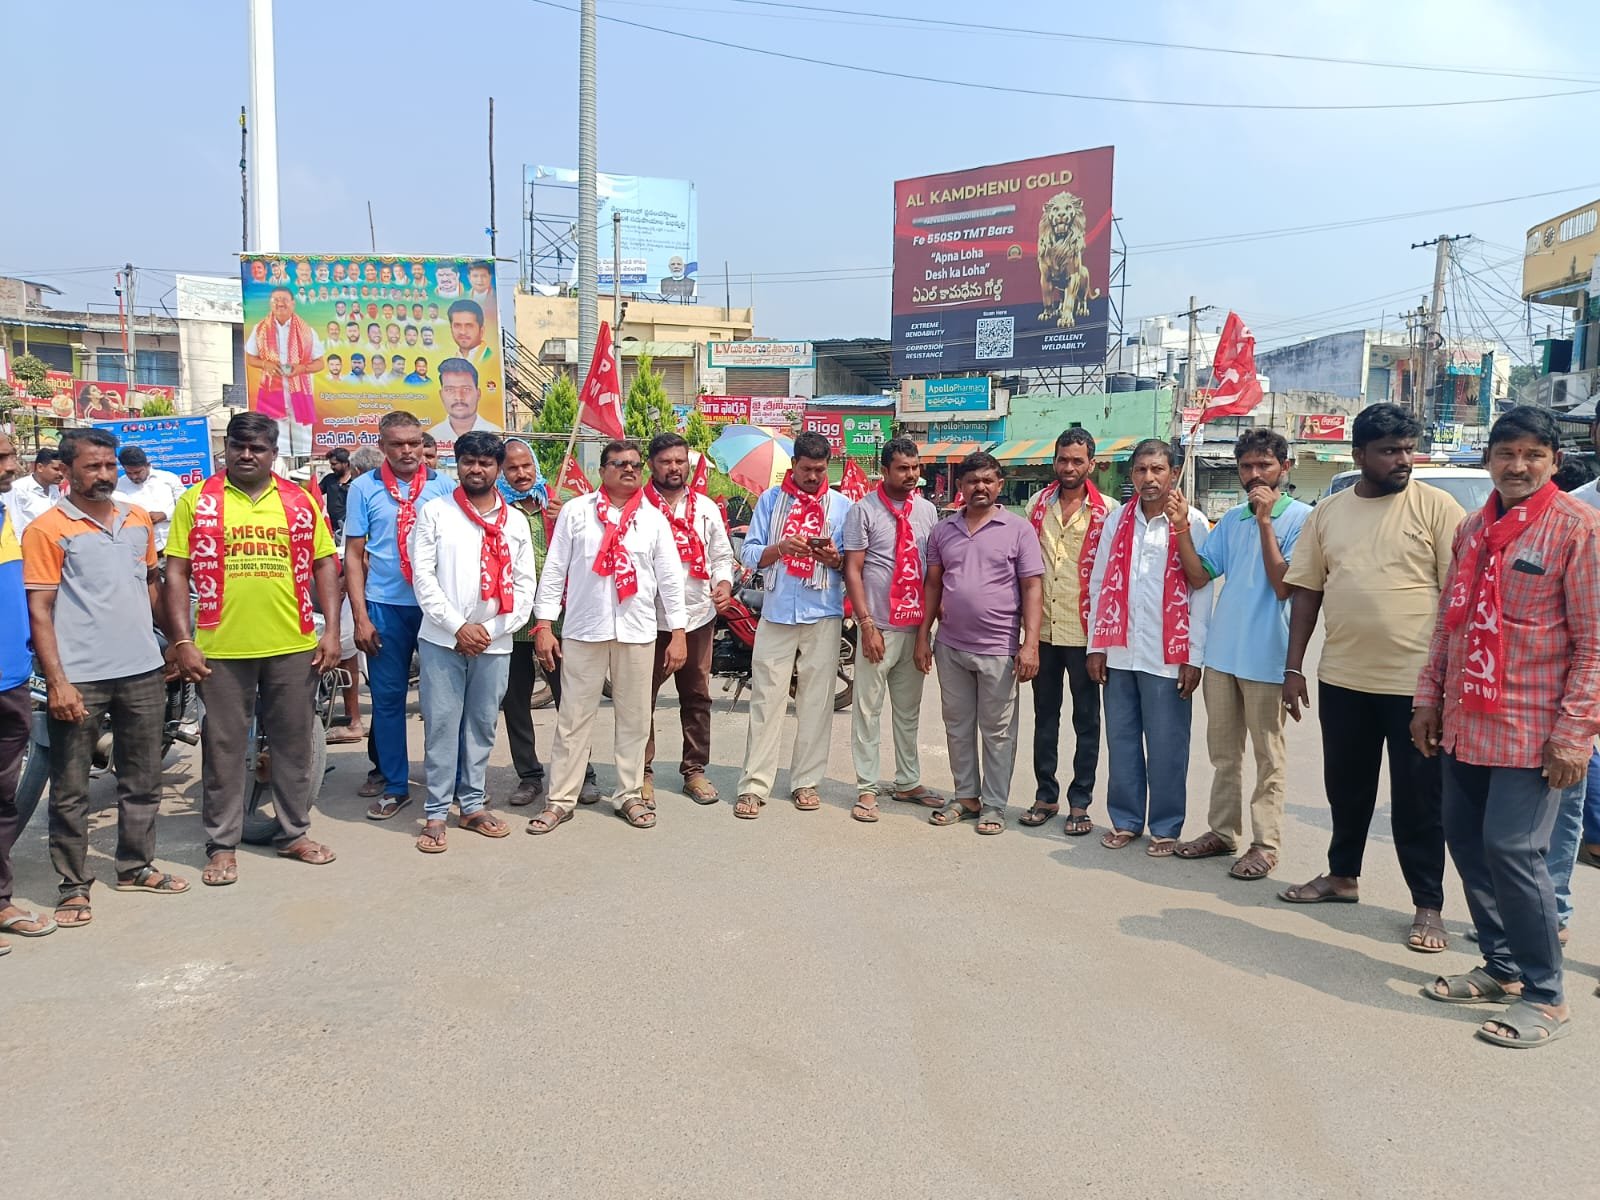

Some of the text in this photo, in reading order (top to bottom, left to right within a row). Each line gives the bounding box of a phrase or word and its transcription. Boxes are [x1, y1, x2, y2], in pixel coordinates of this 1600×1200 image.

[906, 170, 1073, 208] AL KAMDHENU GOLD
[913, 225, 1015, 246] Fe 550SD TMT Bars
[961, 248, 984, 260] Loha
[925, 268, 948, 280] Desh
[949, 266, 960, 278] ka
[940, 281, 982, 300] కామధేను
[985, 278, 1004, 301] గోల్డ్
[911, 321, 940, 330] EXTREME
[1044, 333, 1083, 342] EXCELLENT
[905, 351, 944, 360] RESISTANCE
[807, 421, 840, 436] Bigg
[231, 525, 277, 540] MEGA
[292, 532, 313, 543] CPM
[224, 541, 289, 559] SPORTS
[192, 560, 219, 572] CPM
[198, 602, 218, 612] CPM
[1094, 627, 1122, 637] CPI(M)
